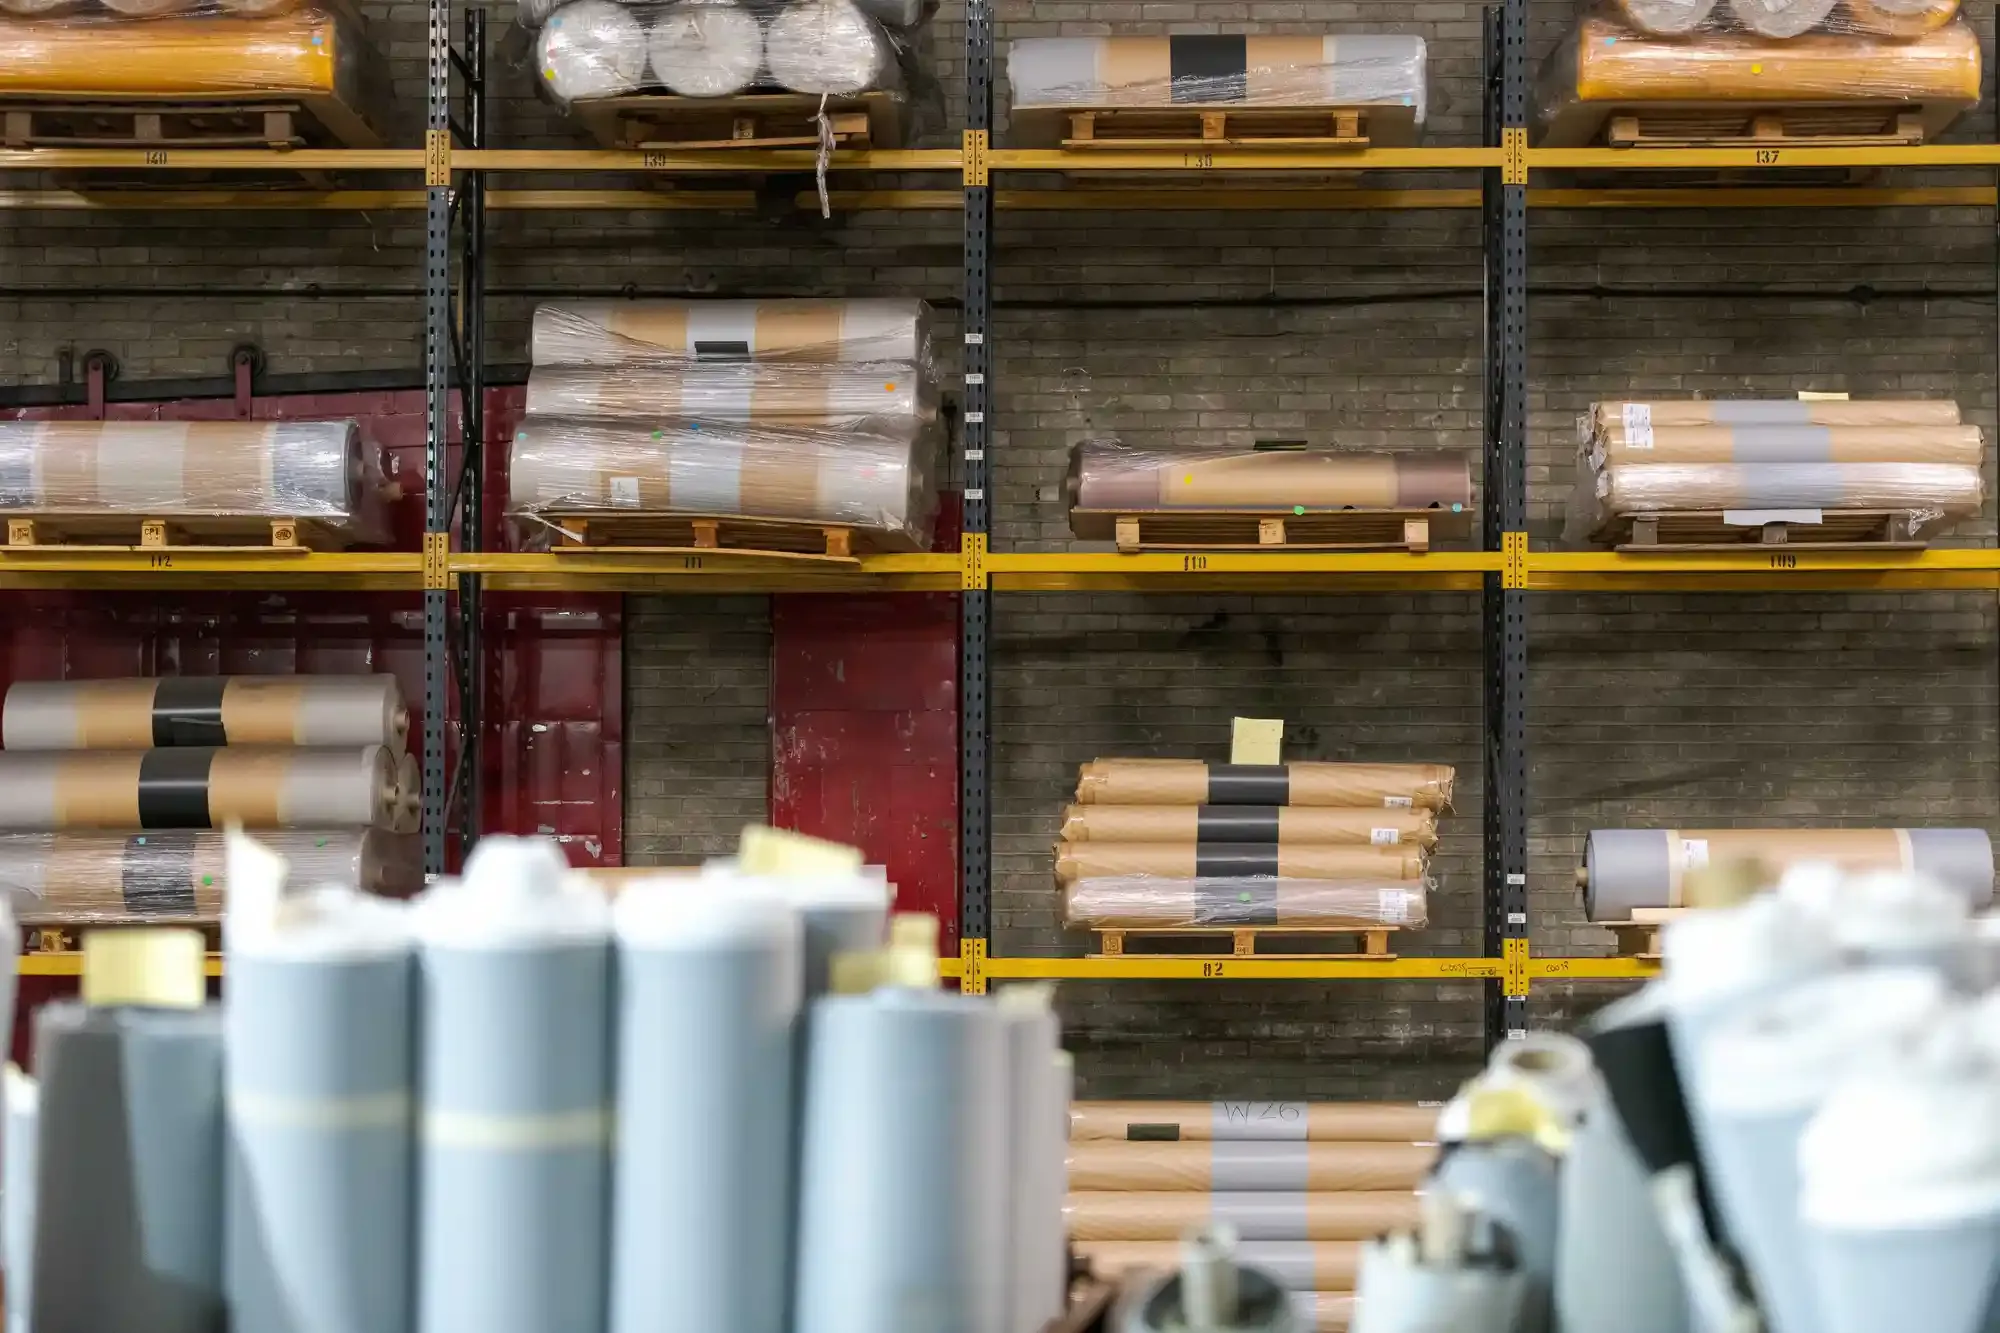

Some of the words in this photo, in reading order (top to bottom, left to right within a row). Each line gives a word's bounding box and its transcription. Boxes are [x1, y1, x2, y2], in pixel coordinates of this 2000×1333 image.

[146, 151, 168, 165] 140
[1756, 149, 1780, 164] 137
[151, 554, 172, 567] 112
[1184, 555, 1207, 571] 110
[1770, 553, 1797, 569] 109
[1203, 962, 1224, 977] 82
